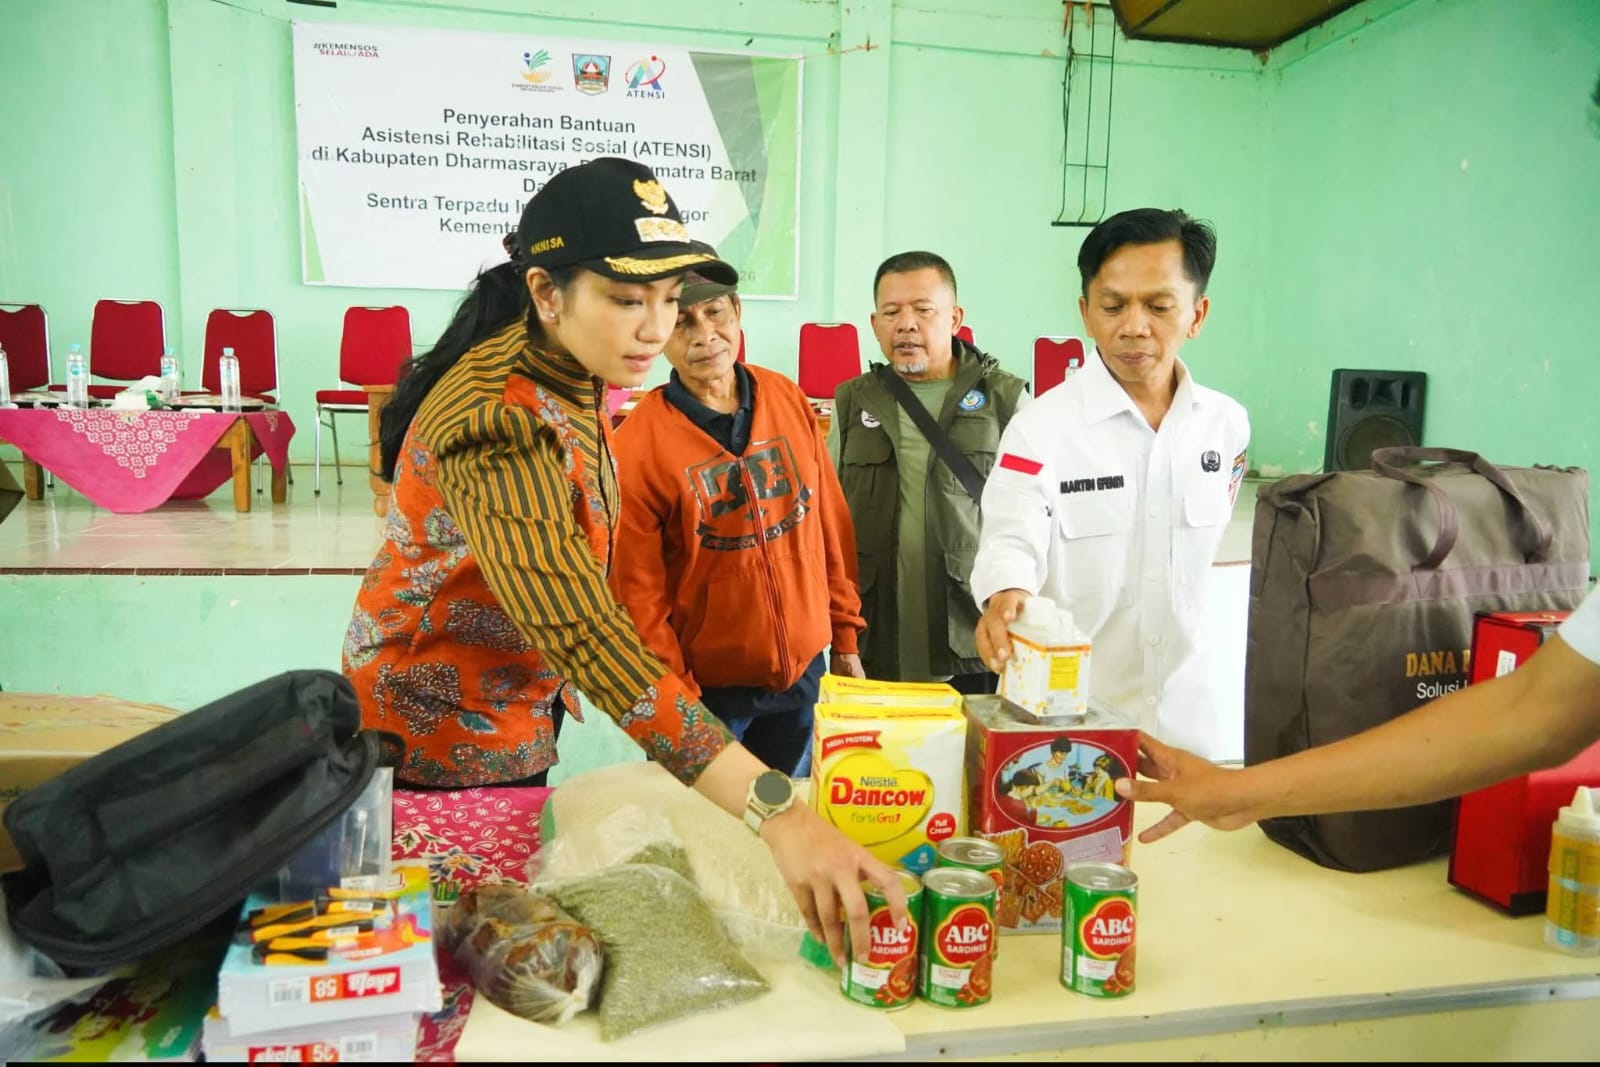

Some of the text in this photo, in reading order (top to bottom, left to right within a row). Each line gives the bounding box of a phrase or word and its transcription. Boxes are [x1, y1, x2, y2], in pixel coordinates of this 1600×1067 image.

[626, 90, 665, 99] ATENSI
[443, 109, 635, 133] Penyerahan Bantuan
[362, 127, 711, 161] Asistensi Rehabilitasi Sosial (ATENSI)
[312, 146, 329, 161] di
[337, 148, 438, 167] Kabupaten
[650, 165, 704, 180] matra
[711, 167, 757, 182] Barat
[367, 193, 428, 210] Sentra
[434, 196, 509, 214] Terpadu
[679, 208, 709, 224] gor
[440, 217, 519, 234] Kemente
[1405, 650, 1457, 677] DANA
[1416, 680, 1460, 699] Solusi
[826, 735, 874, 750] HIGH PROTEIN
[945, 922, 990, 944] ABC
[1091, 915, 1134, 936] ABC
[872, 945, 909, 955] ARDINES
[314, 978, 337, 998] 58
